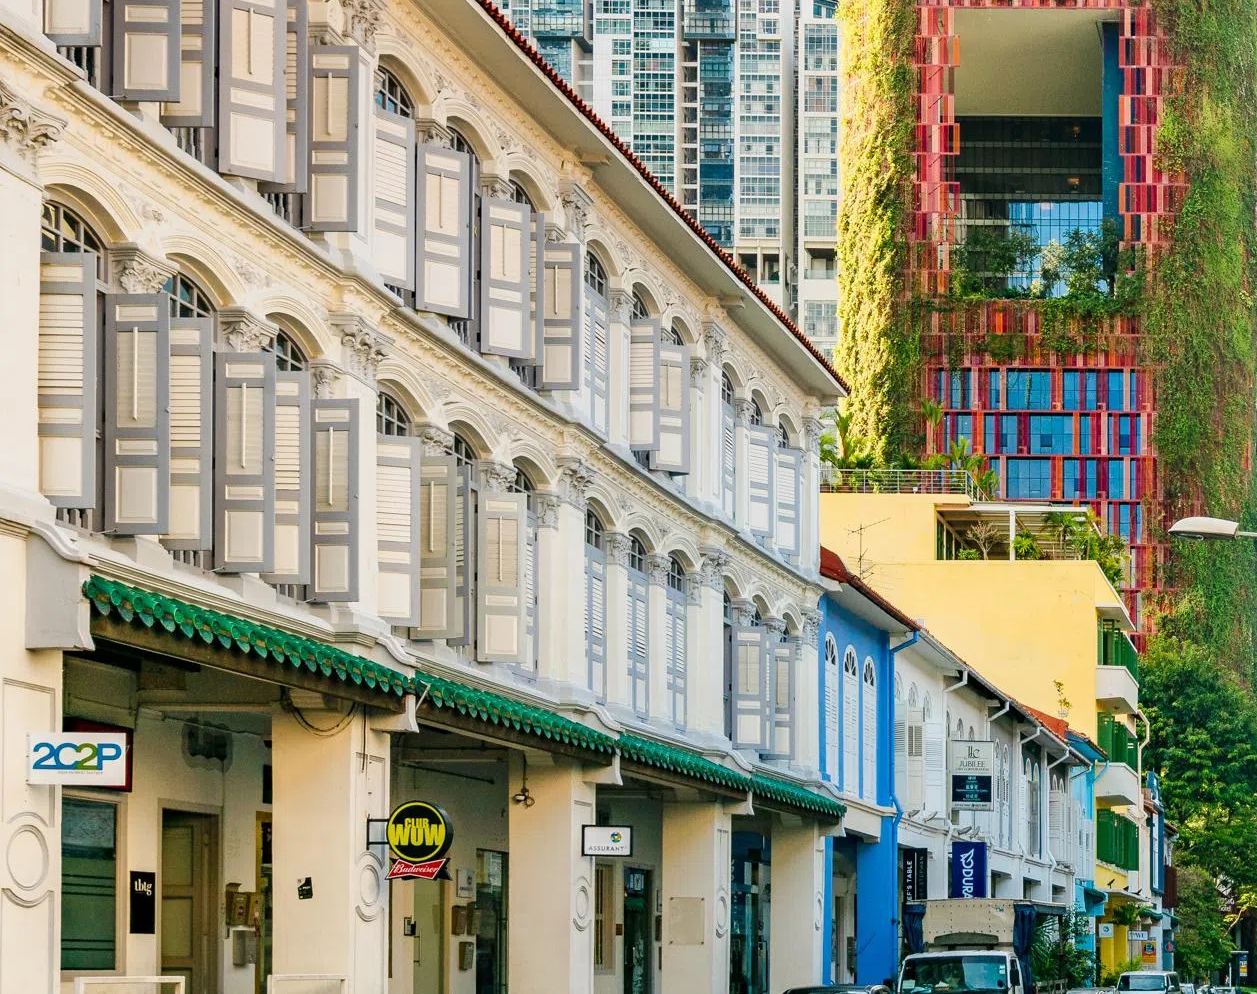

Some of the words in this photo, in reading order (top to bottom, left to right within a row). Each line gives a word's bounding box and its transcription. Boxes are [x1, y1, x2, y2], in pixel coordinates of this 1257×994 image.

[32, 742, 122, 771] 2C2P
[404, 817, 429, 828] CLUB
[393, 864, 439, 874] Budweiser
